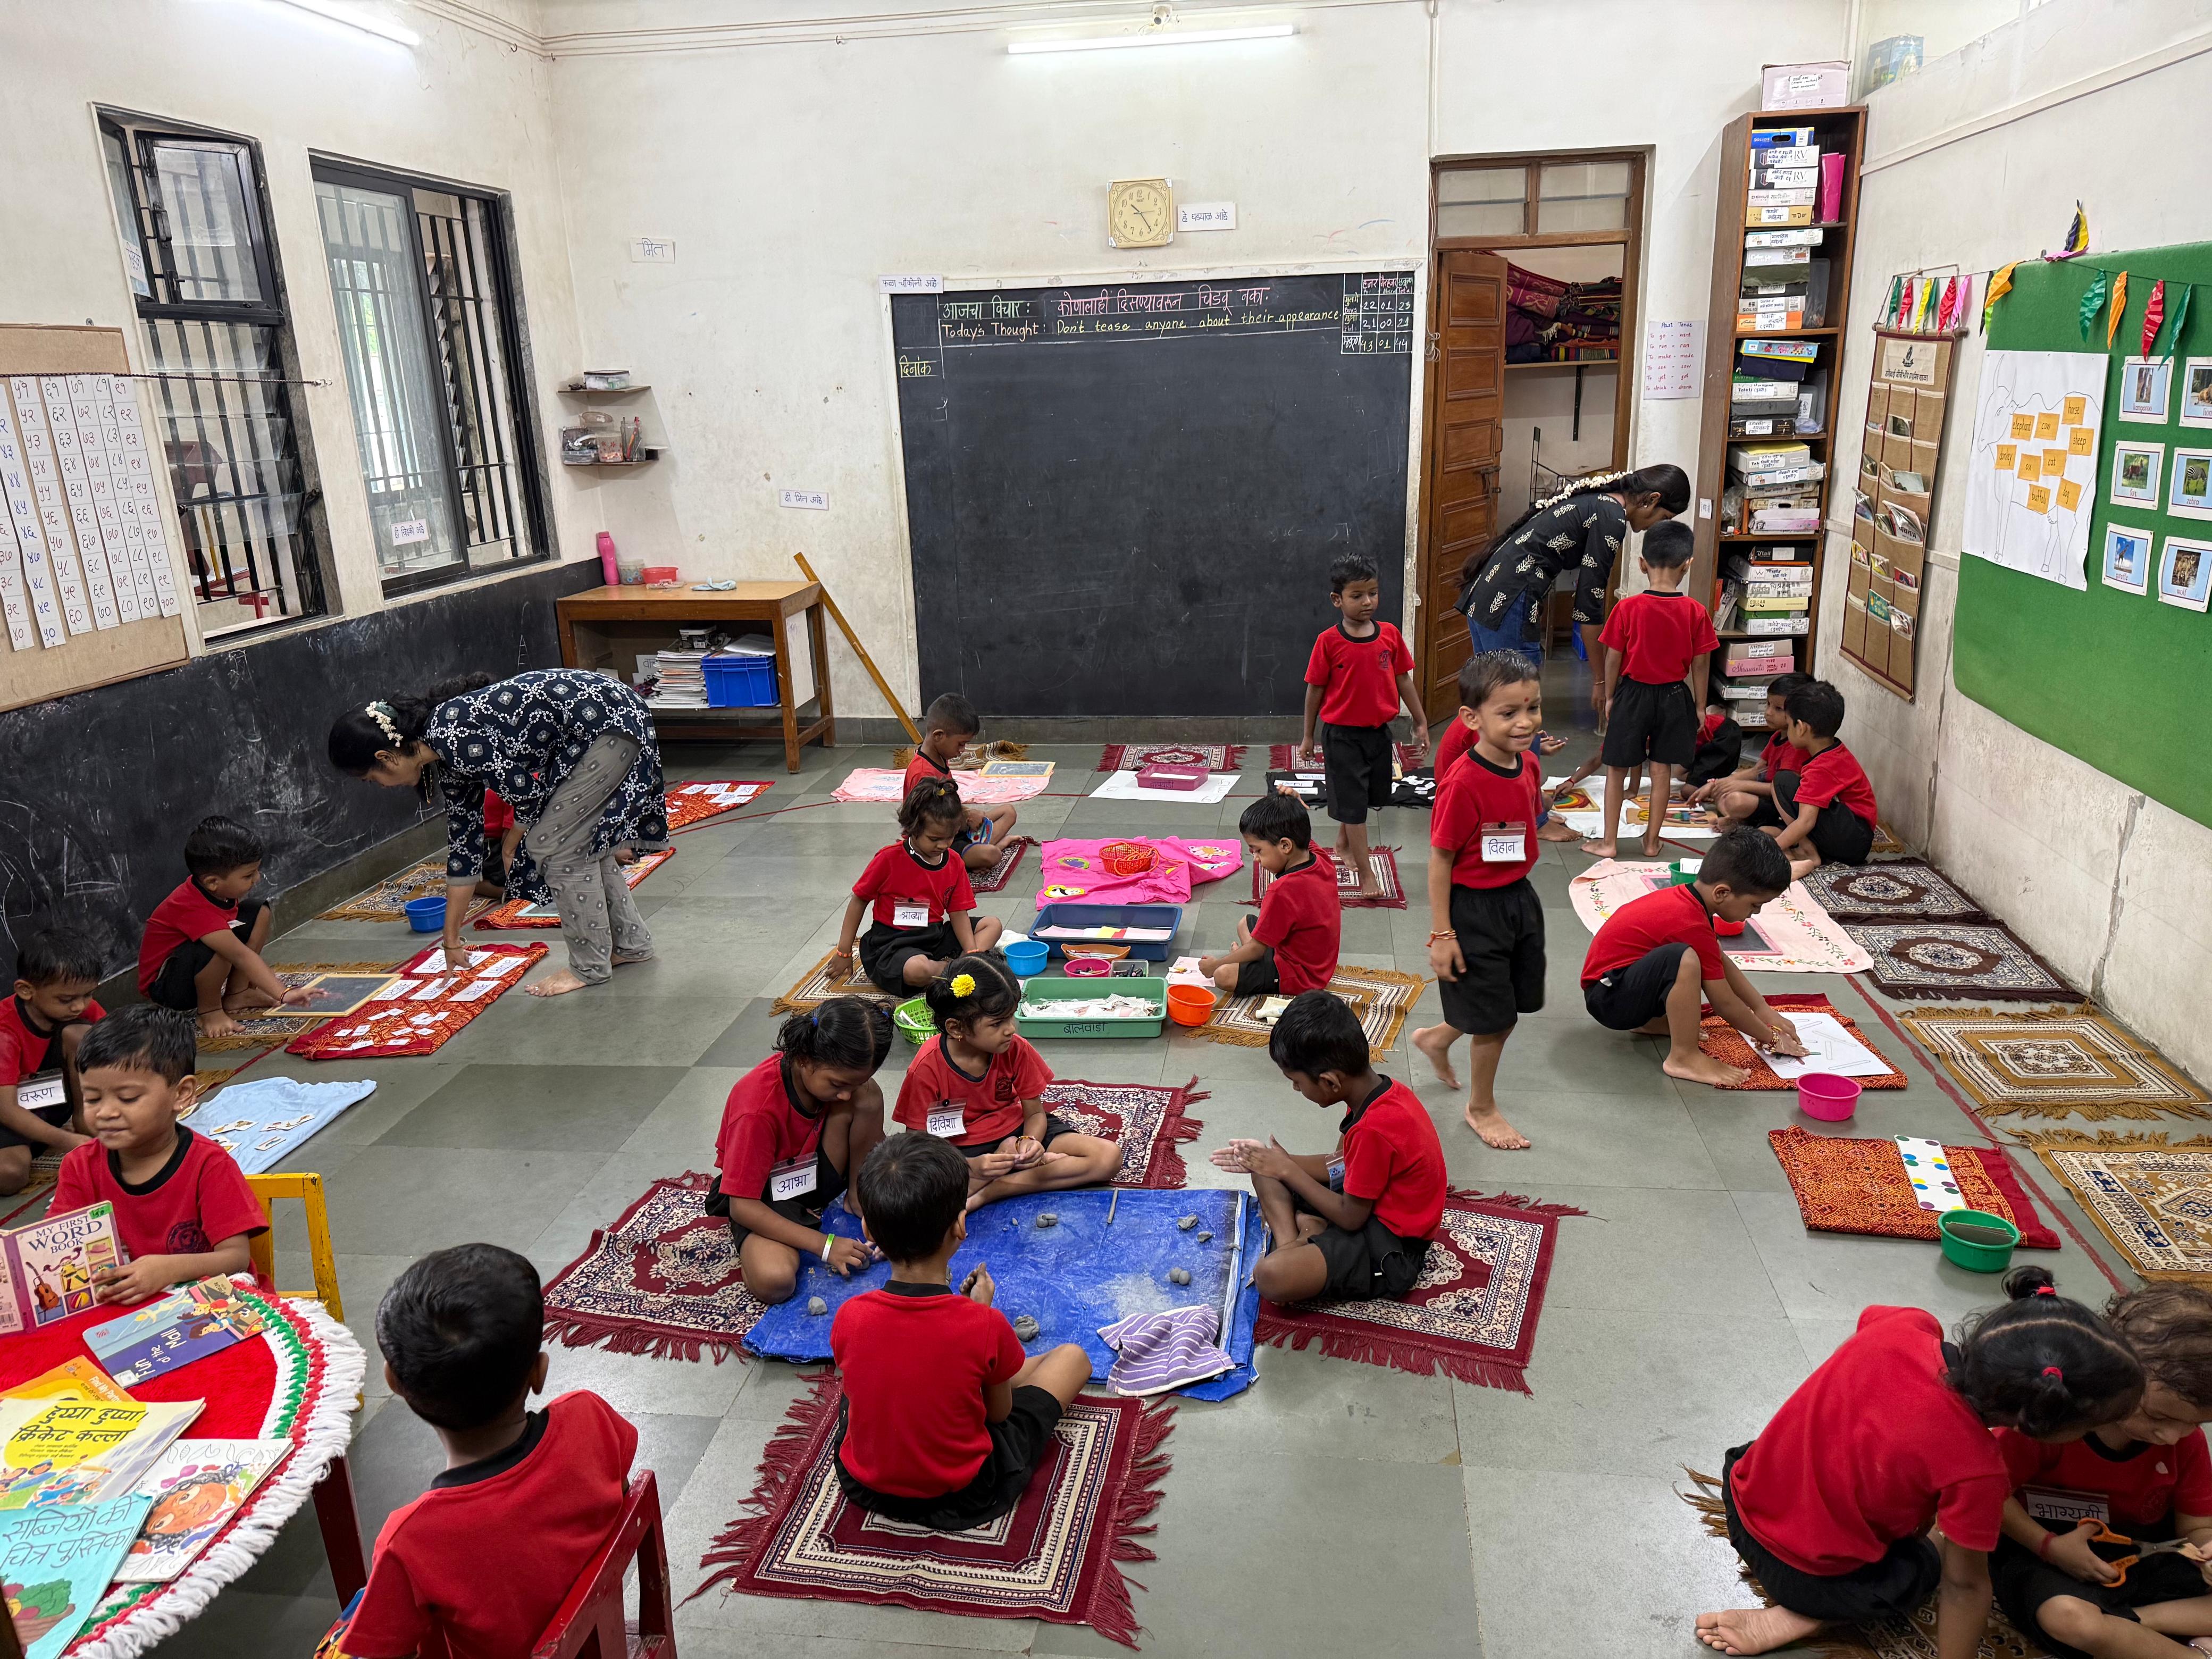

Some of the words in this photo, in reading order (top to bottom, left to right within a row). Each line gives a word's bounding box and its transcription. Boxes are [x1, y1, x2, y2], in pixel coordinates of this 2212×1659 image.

[1795, 150, 1807, 159] RV
[1794, 171, 1807, 180] RV
[1137, 189, 1143, 198] 12
[1147, 192, 1150, 200] 1
[1121, 199, 1127, 208] 10
[1215, 209, 1228, 221] आहे
[1123, 220, 1128, 229] 8
[1154, 219, 1158, 227] 4
[1131, 227, 1135, 235] 7
[1139, 228, 1143, 237] 6
[943, 301, 985, 320] आजचा
[1363, 301, 1378, 310] 22
[941, 323, 985, 342] Today's
[1057, 319, 1085, 336] Don't
[1095, 320, 1131, 332] tease
[1145, 320, 1187, 339] anyone
[1199, 314, 1230, 328] about
[1241, 309, 1275, 324] their
[1379, 339, 1391, 349] 01
[14, 380, 29, 399] ५१
[115, 383, 126, 394] ९१
[2068, 400, 2080, 415] horse
[20, 408, 36, 423] ५२
[121, 408, 133, 422] ९२
[2012, 418, 2031, 435] elephant
[26, 434, 40, 450] ५३
[126, 433, 137, 447] ९३
[2073, 432, 2087, 452] sheep
[131, 457, 141, 470] ९४
[1999, 448, 2013, 466] donkey
[2048, 457, 2057, 466] cat
[32, 460, 46, 475] ५४
[7, 471, 21, 488] ४४
[38, 485, 51, 502] ५५
[136, 483, 147, 494] ९५
[13, 500, 27, 514] ४५
[142, 504, 153, 515] ९६
[44, 511, 58, 525] ५६
[20, 526, 37, 539] ४६
[147, 529, 157, 540] ९७
[49, 536, 62, 551] ५७
[27, 552, 40, 564] ४७
[153, 551, 162, 564] ९८
[56, 560, 70, 577] ५८
[1, 576, 12, 591] ३८
[32, 577, 44, 589] ४८
[158, 574, 170, 586] ९९
[63, 585, 76, 600] ५९
[7, 604, 20, 618] ३९
[37, 601, 51, 614] ४९
[69, 609, 82, 625] ६०
[12, 628, 24, 641] ४०
[44, 627, 56, 641] ५०
[1488, 839, 1519, 854] विहान
[928, 1116, 959, 1132] दिविशा
[776, 1173, 810, 1193] आभा
[36, 1226, 54, 1238] MY
[59, 1214, 89, 1231] FIRST
[28, 1220, 103, 1252] WORD
[51, 1236, 84, 1254] BOOK
[160, 1327, 187, 1350] Mall
[135, 1358, 156, 1379] Fun
[0, 1541, 57, 1569] चित्र
